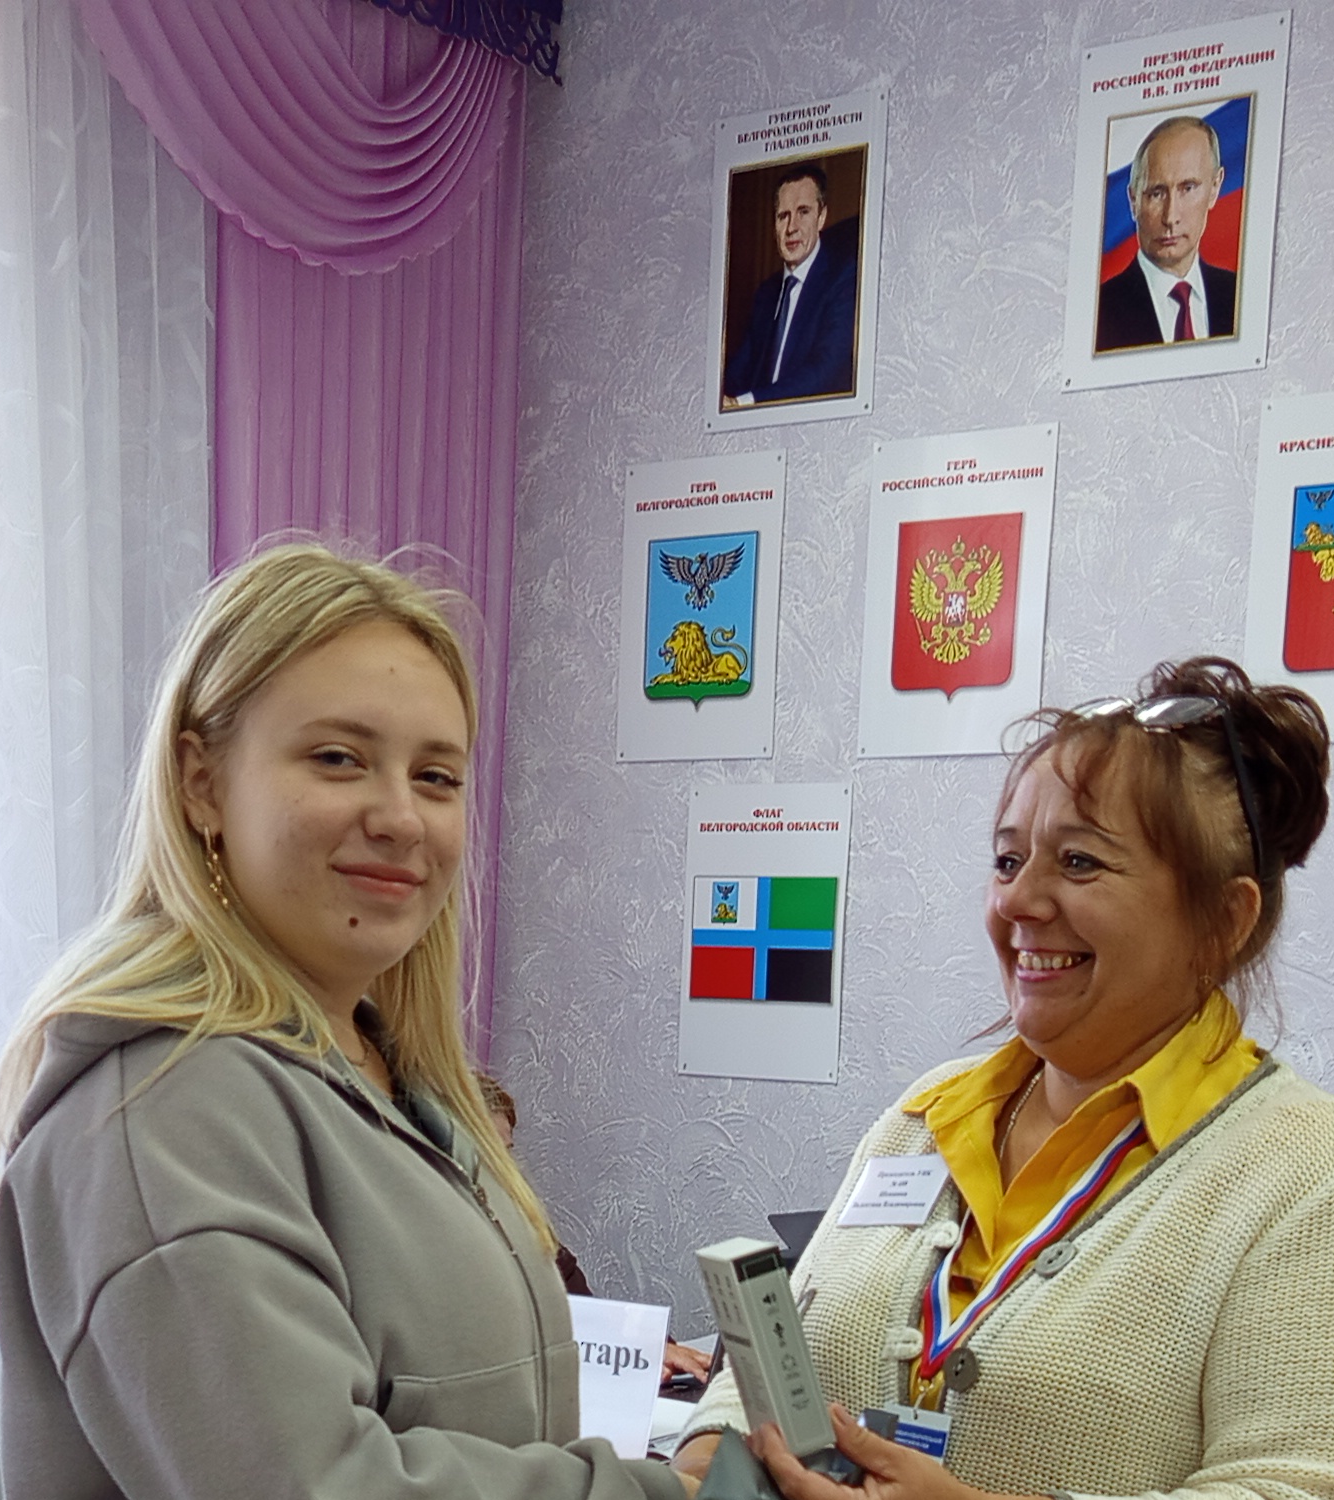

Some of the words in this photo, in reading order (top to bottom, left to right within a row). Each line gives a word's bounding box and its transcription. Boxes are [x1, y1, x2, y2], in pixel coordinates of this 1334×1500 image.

[1143, 42, 1224, 68] ПРЕЗИДЕНТ
[1092, 65, 1185, 93] РОССИЙСКОЙ
[1189, 49, 1275, 74] ФЕДЕРАЦИИ
[1142, 85, 1168, 99] В.В.
[1173, 75, 1221, 94] ПУТИН
[768, 103, 831, 125] ГУБЕРНАТОР
[737, 120, 813, 144] БЕЛГОРОДСКОЙ
[816, 111, 863, 129] ОБЛАСТИ
[764, 135, 810, 152] ГЛАДКОВ
[812, 131, 831, 143] В.В.
[946, 458, 977, 471] ГЕРБ
[690, 481, 717, 494] ГЕРБ
[881, 473, 964, 492] РОССИЙСКОЙ
[967, 466, 1044, 484] ФЕДЕРАЦИИ
[636, 494, 719, 513] БЕЛГОРОДСКОЙ
[722, 489, 773, 504] ОБЛАСТИ
[752, 808, 784, 819] ФЛАГ
[699, 820, 785, 833] БЕЛГОРОДСКОЙ
[787, 821, 840, 832] ОБЛАСТИ
